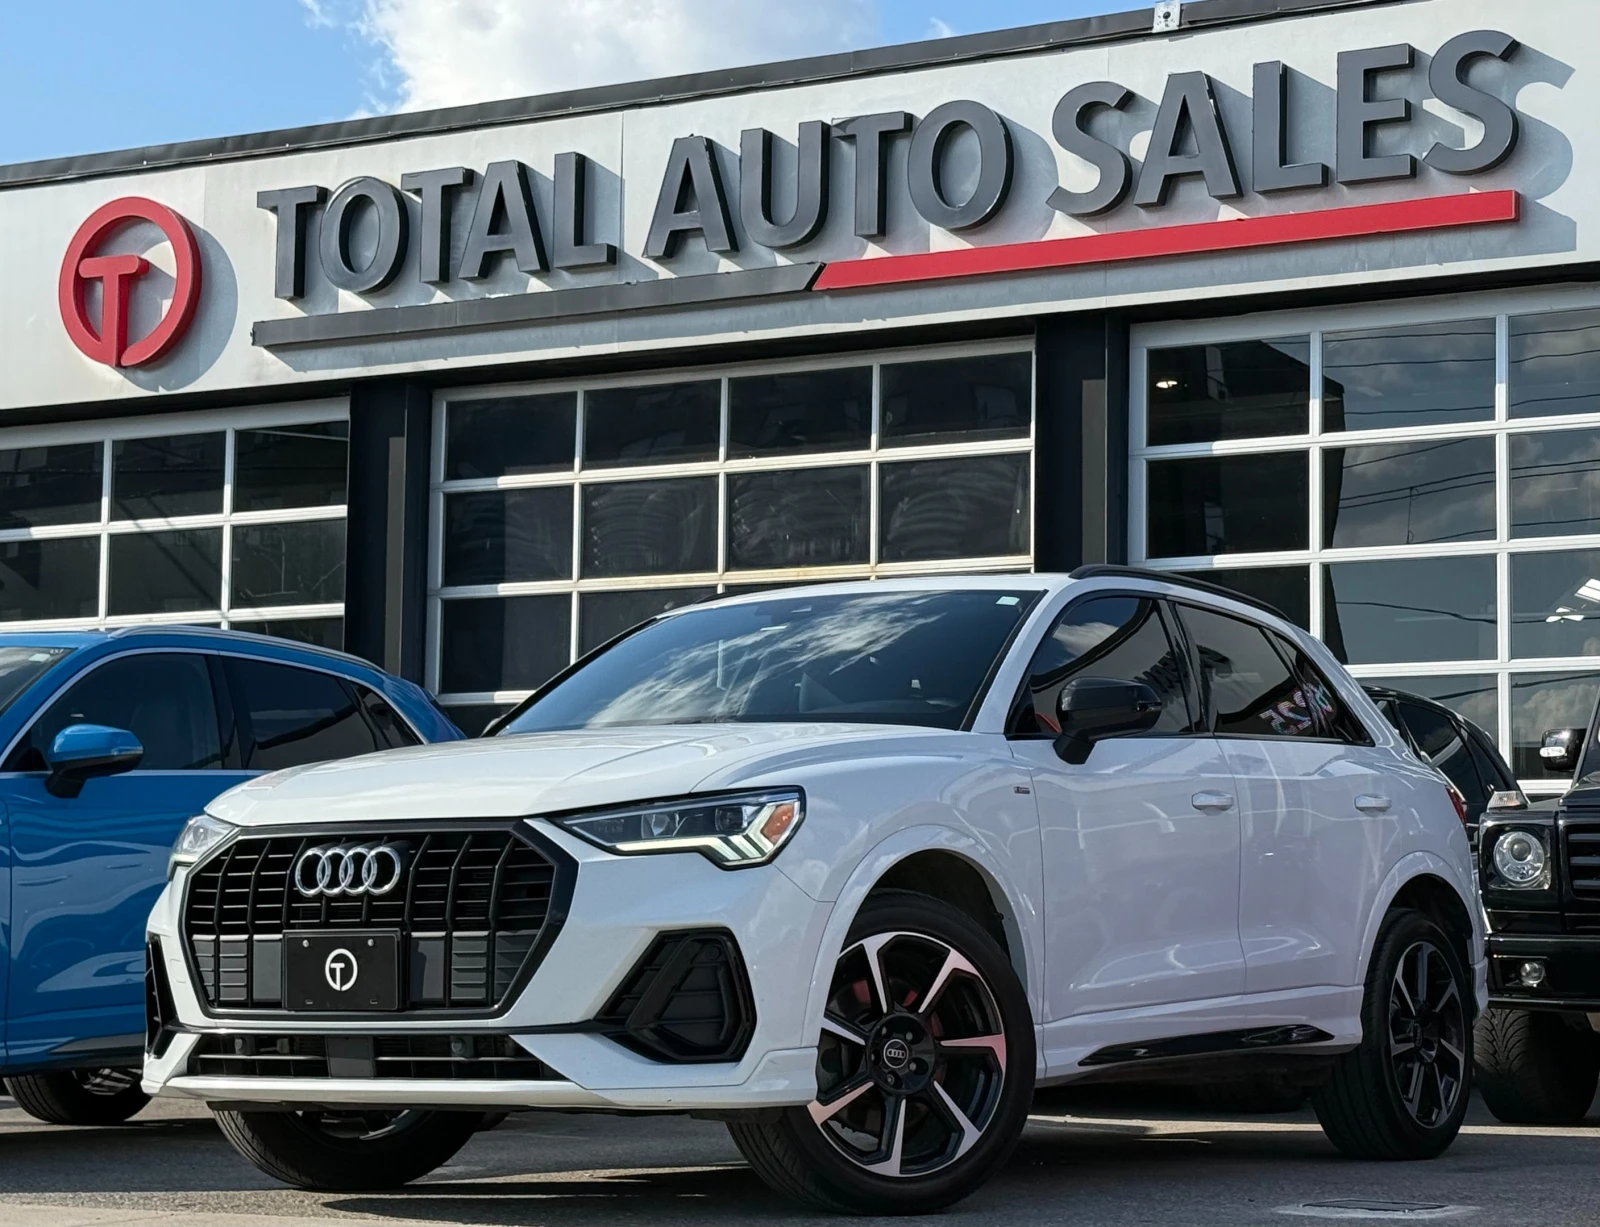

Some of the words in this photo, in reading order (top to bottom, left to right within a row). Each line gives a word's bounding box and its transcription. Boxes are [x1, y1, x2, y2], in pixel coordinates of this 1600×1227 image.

[257, 151, 617, 299] TOTAL
[642, 99, 1014, 258] AUTO
[1045, 30, 1521, 216] SALES
